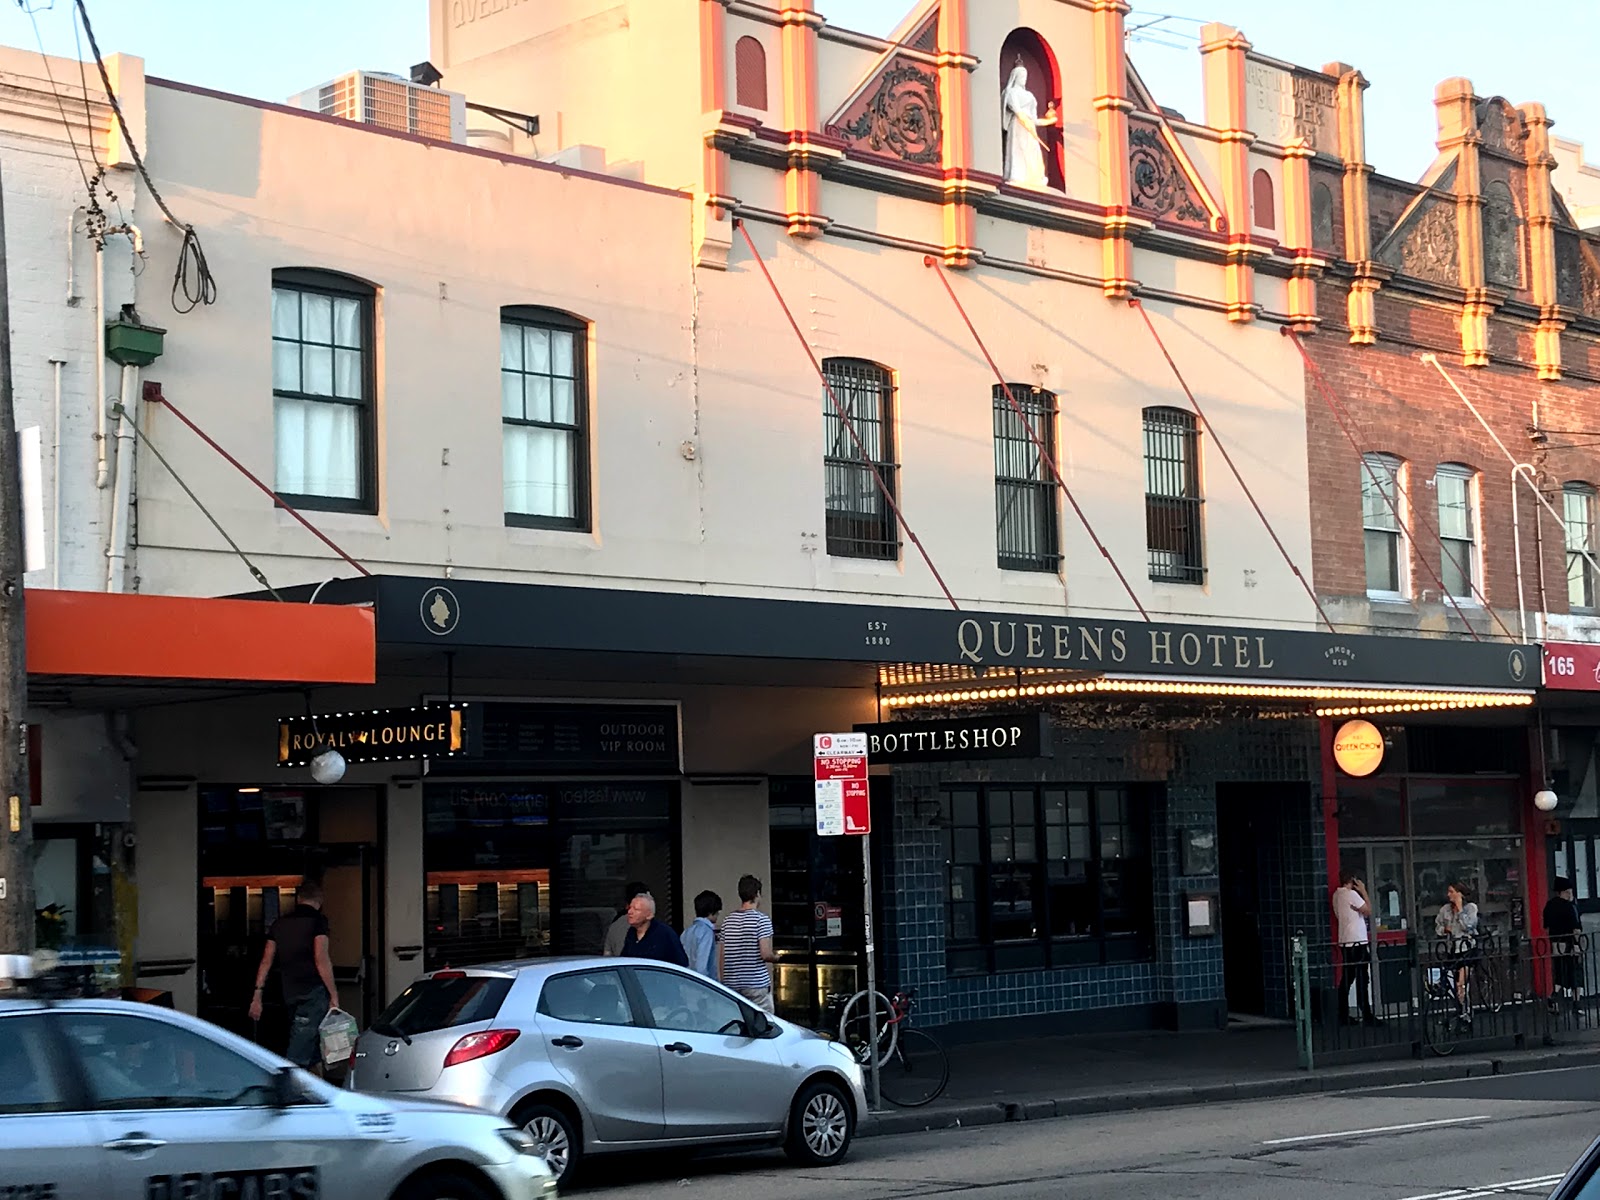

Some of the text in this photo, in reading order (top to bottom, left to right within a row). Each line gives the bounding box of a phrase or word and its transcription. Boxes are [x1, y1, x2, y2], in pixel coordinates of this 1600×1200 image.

[867, 621, 888, 631] EST
[865, 636, 891, 646] 1880
[957, 619, 1274, 669] QUEENS HOTEL
[1548, 656, 1575, 676] 165
[600, 723, 665, 736] OUTDOOR
[293, 723, 446, 750] ROYAL LOUNGE
[870, 726, 1021, 753] BOTTLESHOP
[600, 740, 665, 752] VIP ROOM
[1335, 743, 1358, 752] QUEEN
